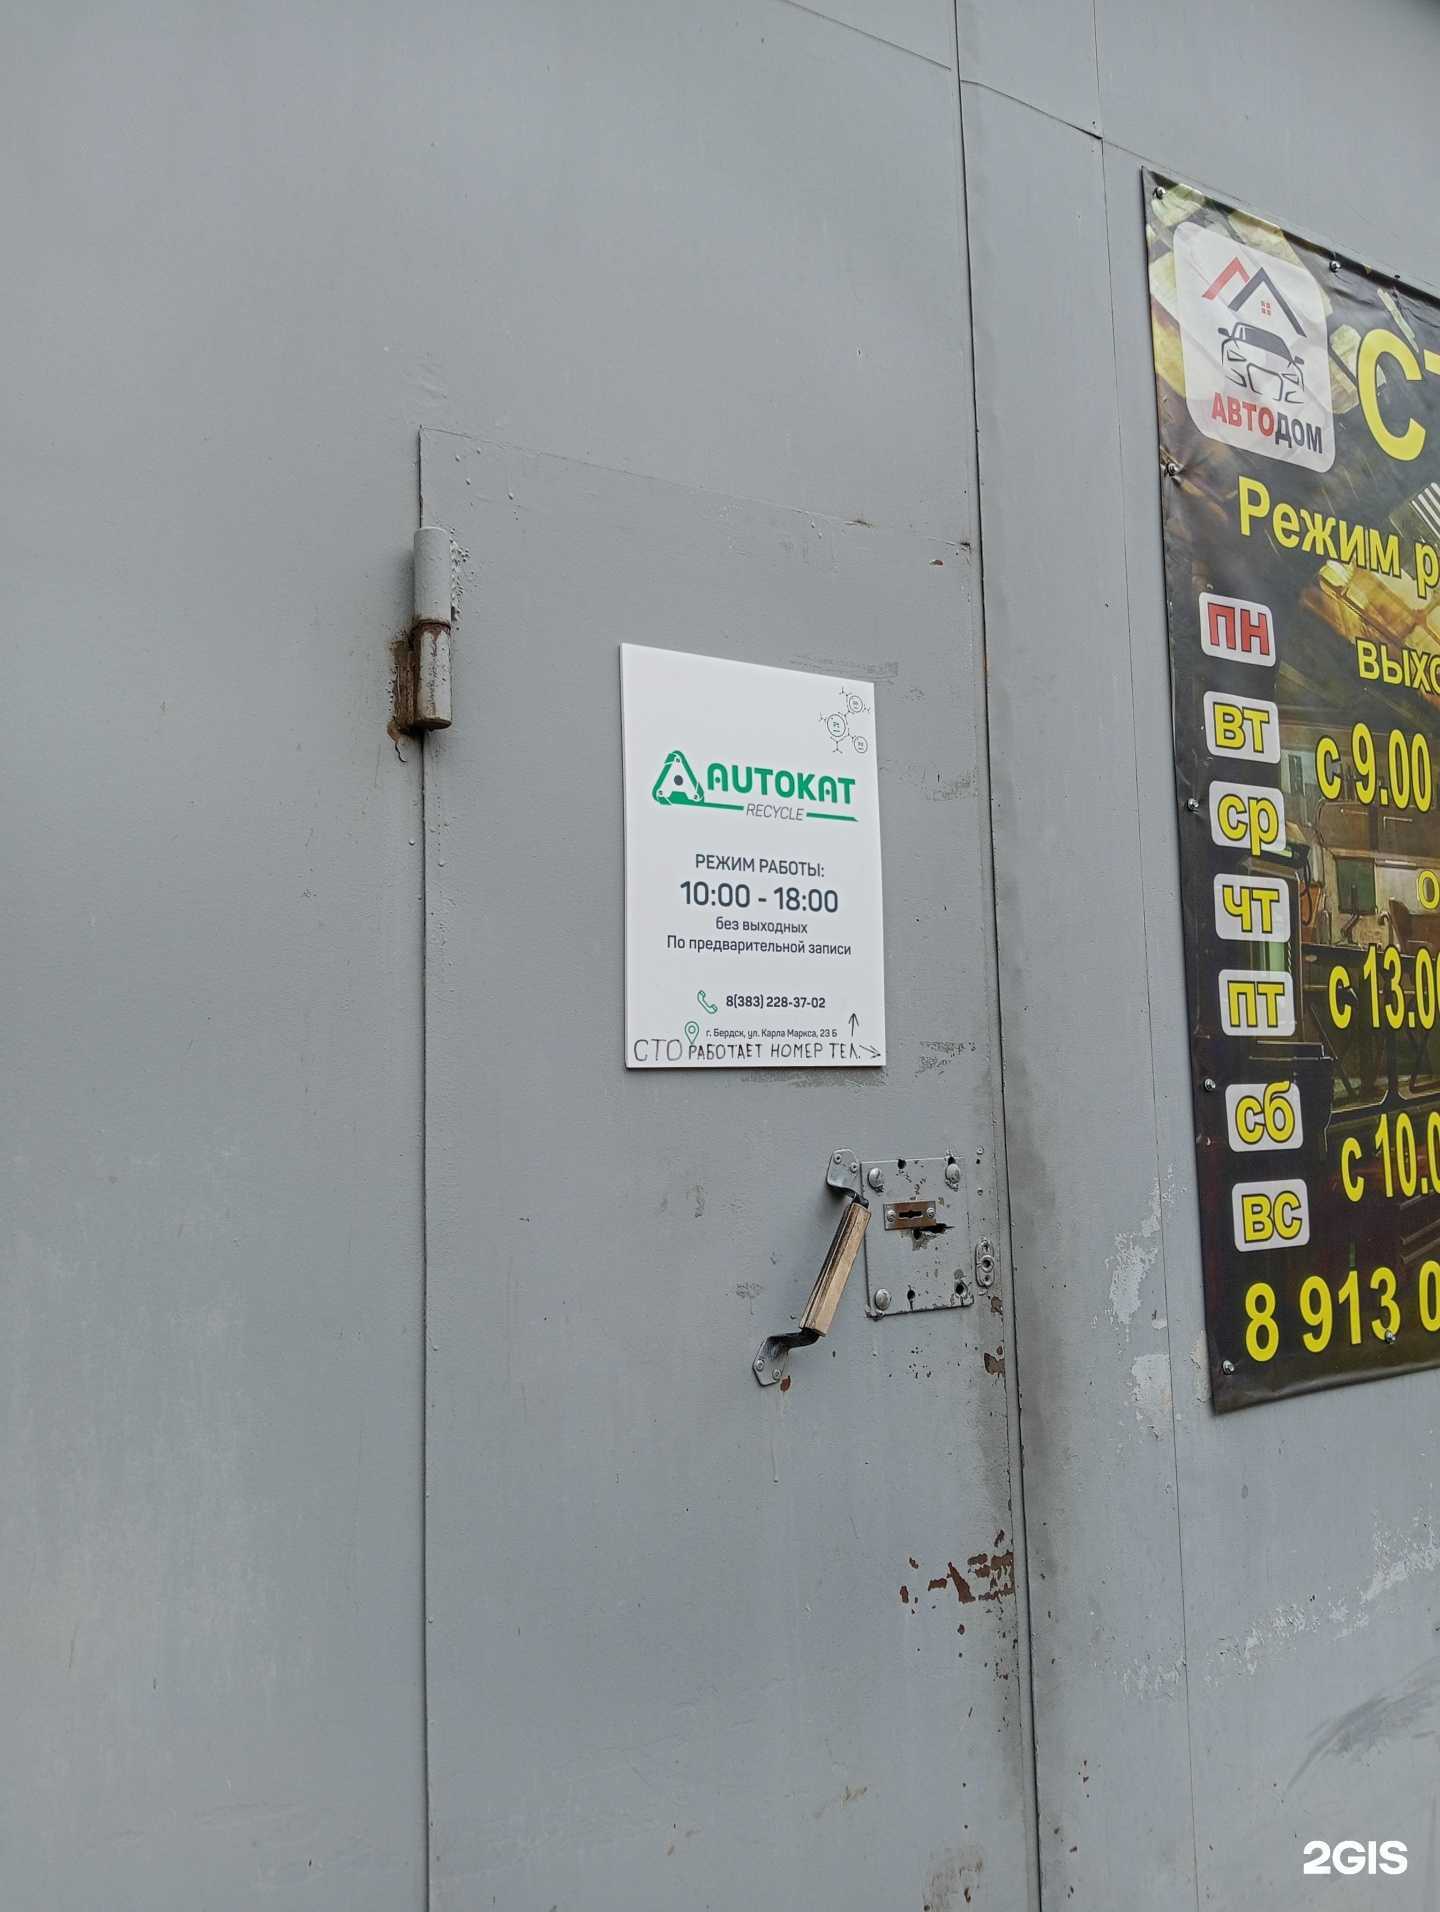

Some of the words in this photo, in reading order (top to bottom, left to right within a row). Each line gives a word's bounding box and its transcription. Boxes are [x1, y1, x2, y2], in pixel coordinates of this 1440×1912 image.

[1357, 327, 1440, 462] С
[1211, 392, 1323, 453] АВТОДОМ
[1238, 476, 1402, 578] Режим
[707, 762, 856, 805] AUTOKAT
[1352, 722, 1432, 813] 9.00
[746, 803, 804, 821] RECYCLE
[695, 854, 755, 873] РЕЖИМ
[759, 859, 825, 878] РАБОТЫ:
[680, 881, 750, 908] 10:00
[774, 887, 838, 913] 18:00
[716, 916, 739, 931] без
[742, 920, 808, 934] выходных
[667, 935, 685, 949] По
[689, 938, 805, 954] предварительной
[809, 943, 851, 955] записи
[726, 994, 764, 1009] 8(383)
[766, 996, 826, 1009] 228-37-02
[1363, 943, 1440, 1030] 13.0
[747, 1030, 760, 1039] ул.
[761, 1029, 786, 1039] Карла
[787, 1029, 818, 1039] Маркса,
[820, 1029, 831, 1038] 23
[633, 1039, 683, 1062] СТО
[688, 1043, 763, 1061] РАБОТАЕТ
[770, 1043, 824, 1059] НОМЕР
[1245, 1282, 1279, 1363] 8
[1300, 1266, 1401, 1353] 913
